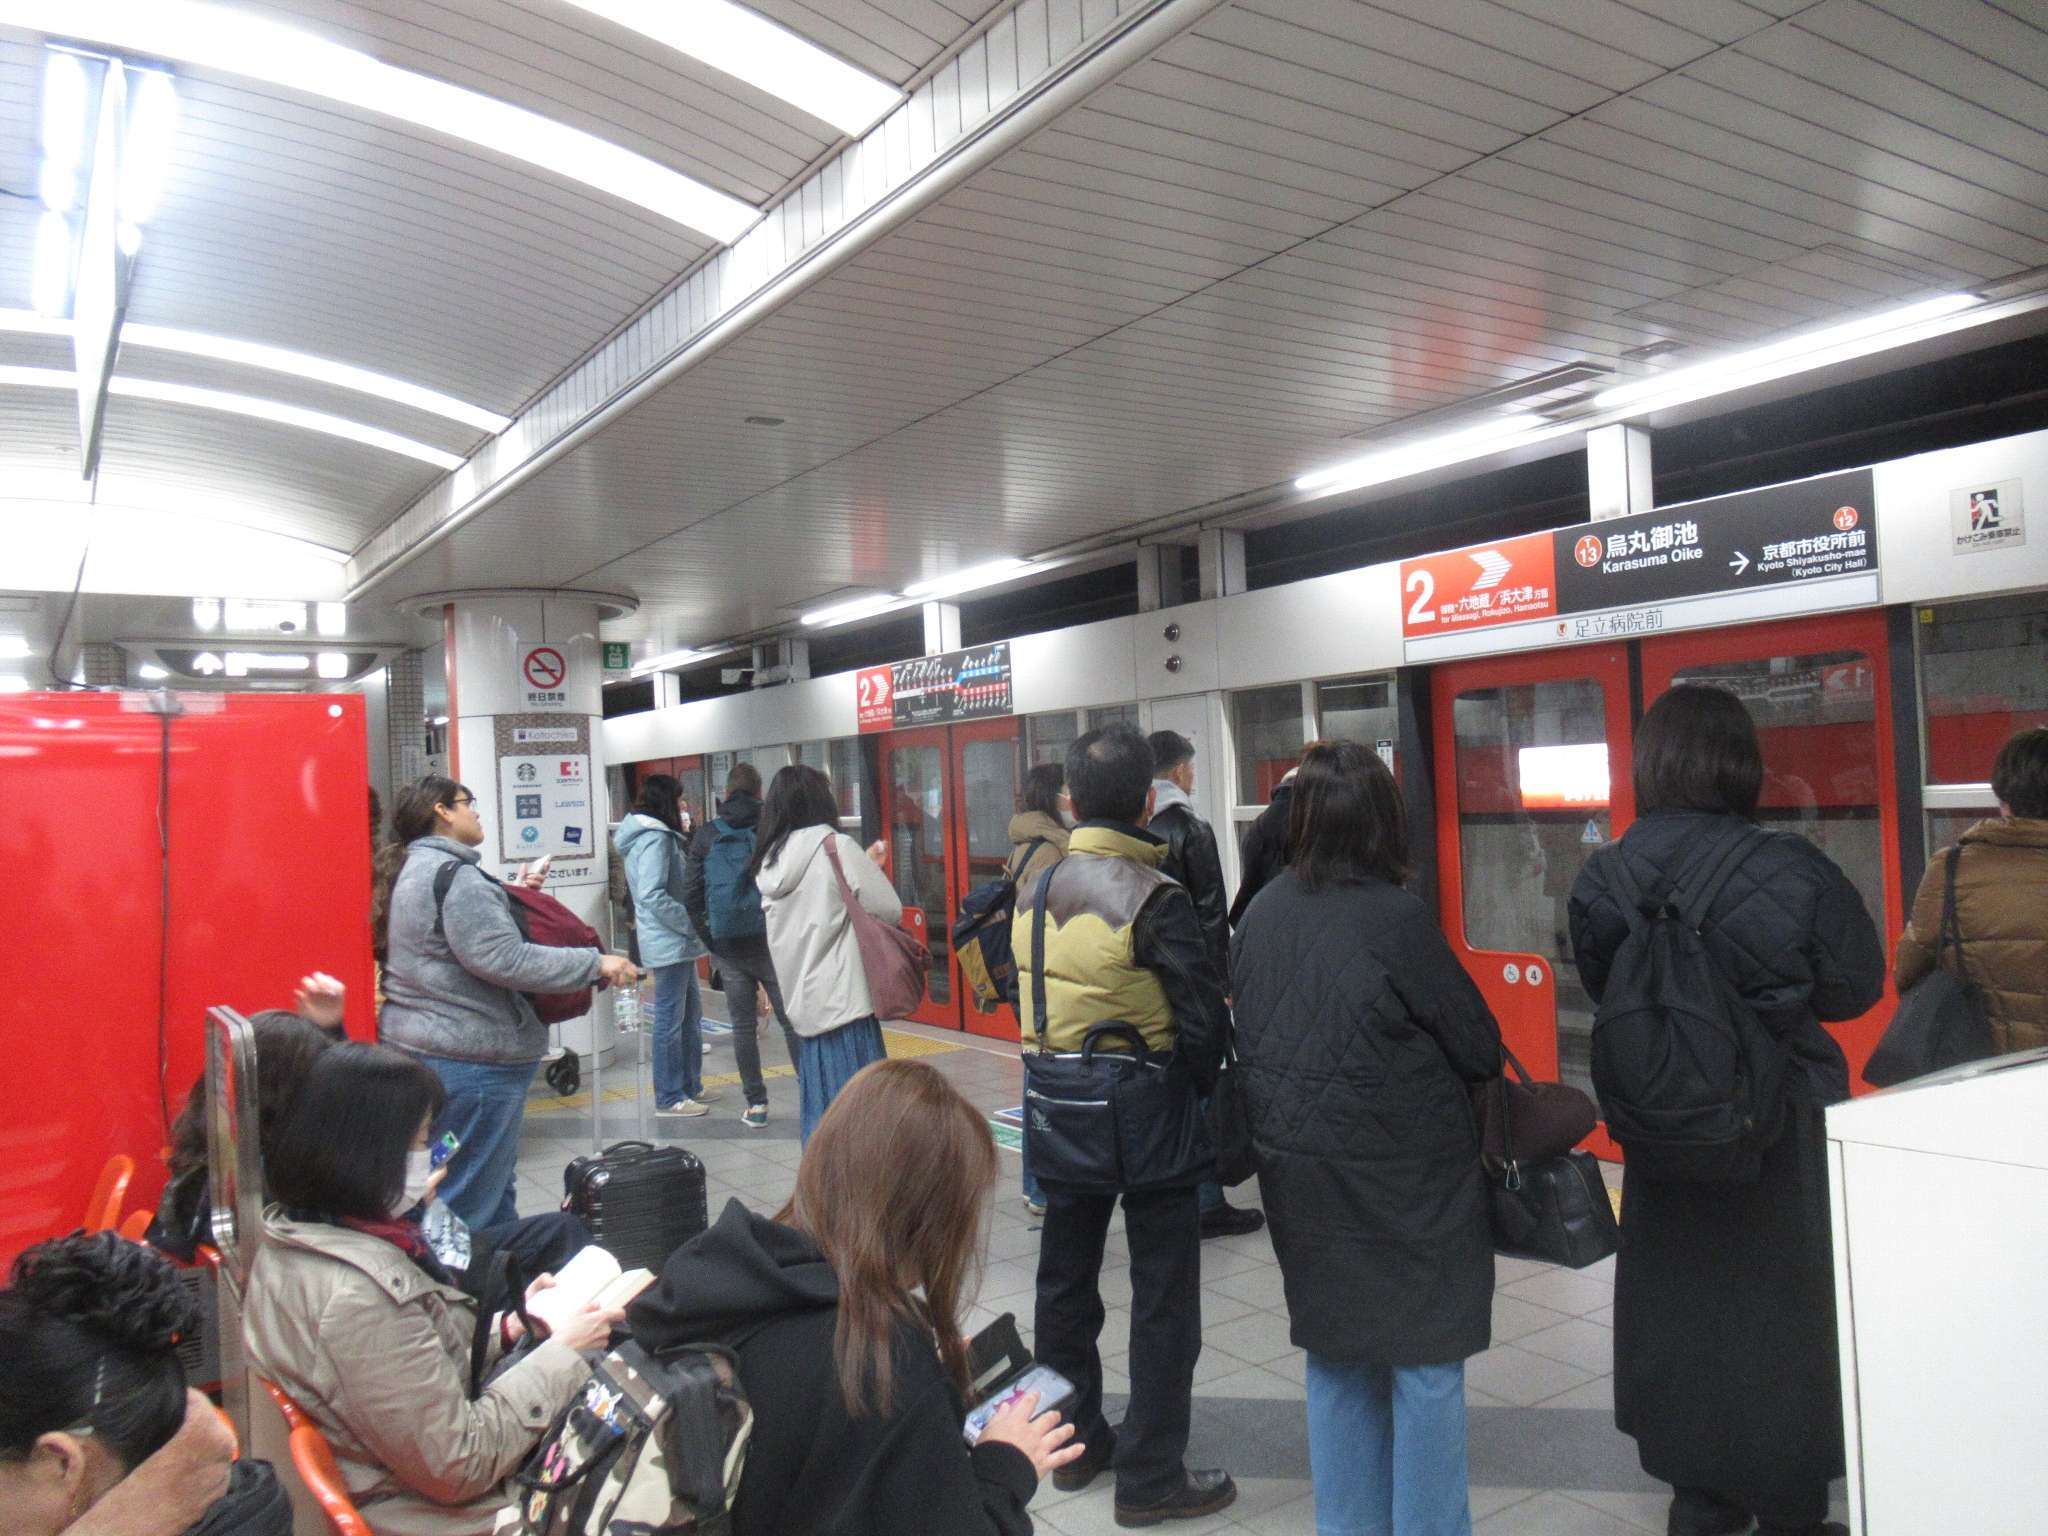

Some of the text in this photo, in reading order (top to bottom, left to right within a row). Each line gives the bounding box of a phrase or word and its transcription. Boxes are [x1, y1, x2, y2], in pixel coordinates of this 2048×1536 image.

[1838, 515, 1854, 528] 12
[1583, 538, 1591, 548] T
[1605, 520, 1699, 559] 烏丸御池
[1762, 529, 1866, 561] 京都市役所前
[1579, 547, 1597, 563] 13
[1602, 547, 1703, 574] Karasuma Oike
[1757, 548, 1867, 573] Kyoto Shiyakusho-mae
[1792, 557, 1867, 578] (Kyoto City Hall)
[1405, 569, 1436, 625] 2
[1574, 607, 1664, 638] 足立病院前
[860, 677, 870, 707] 2
[1530, 970, 1537, 981] 4
